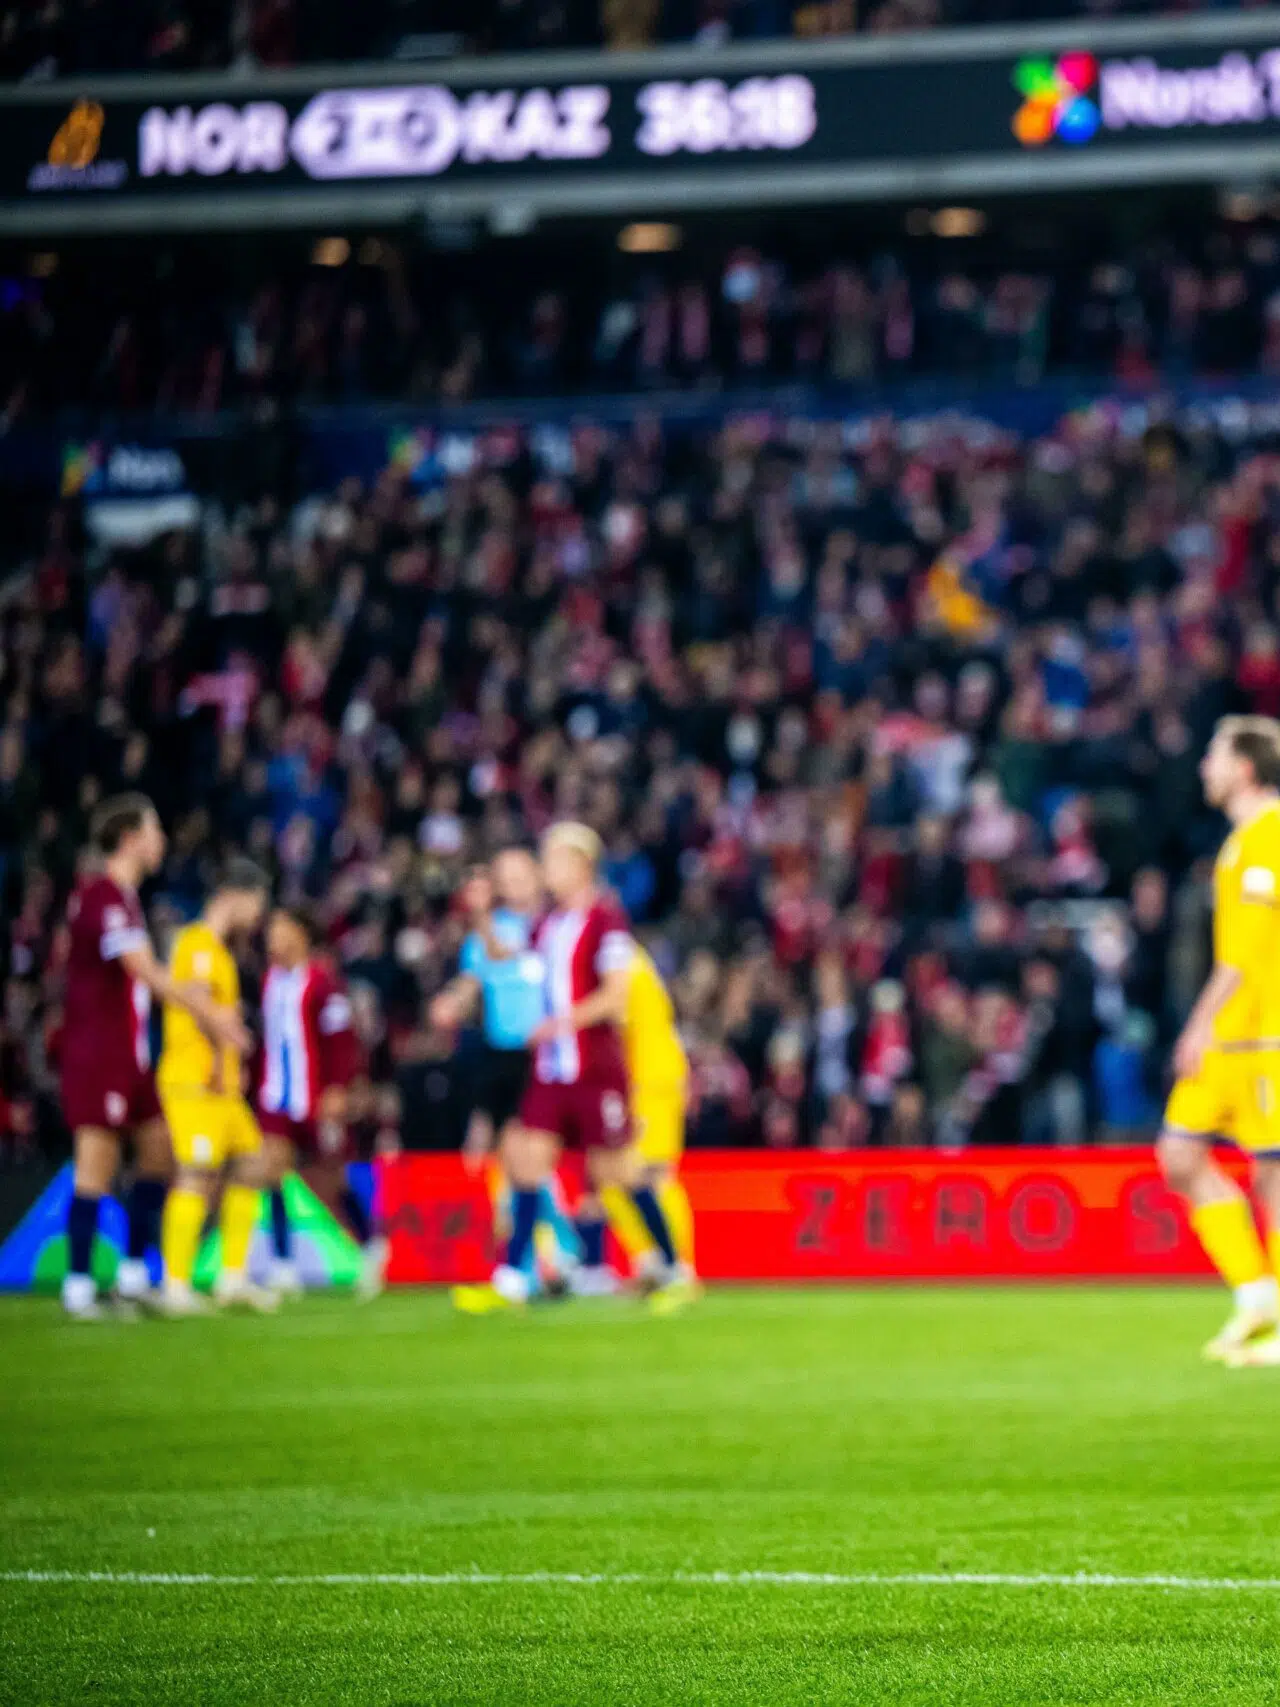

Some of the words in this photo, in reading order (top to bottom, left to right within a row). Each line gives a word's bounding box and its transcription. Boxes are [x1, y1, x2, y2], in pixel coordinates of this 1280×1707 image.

[1102, 58, 1263, 127] Norsk
[140, 103, 286, 176] NOR
[463, 86, 609, 161] KAZ
[796, 1184, 1076, 1250] ZERO
